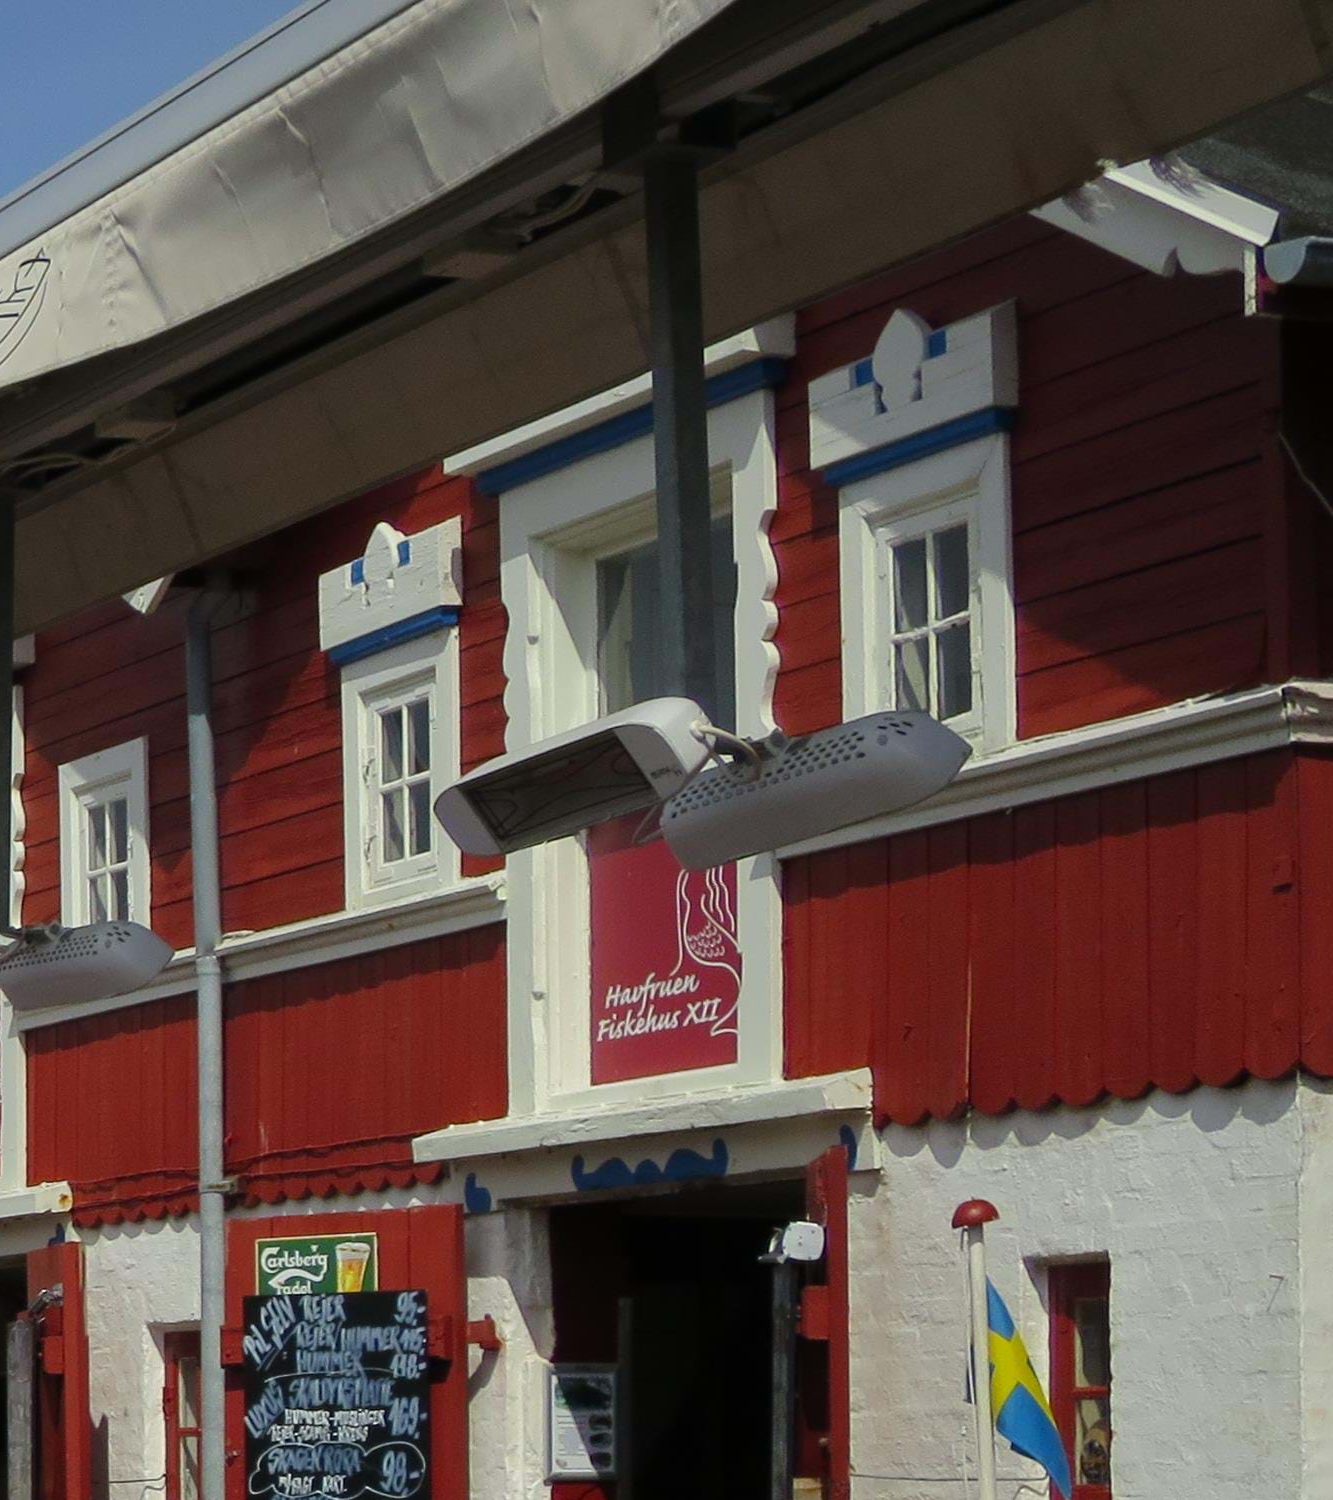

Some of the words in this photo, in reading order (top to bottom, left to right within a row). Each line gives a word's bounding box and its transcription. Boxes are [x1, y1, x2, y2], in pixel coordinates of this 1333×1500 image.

[605, 972, 700, 1016] Havfruen
[596, 1005, 681, 1042] Fiskehus
[683, 998, 721, 1026] XII
[261, 1245, 329, 1274] Carlsberg
